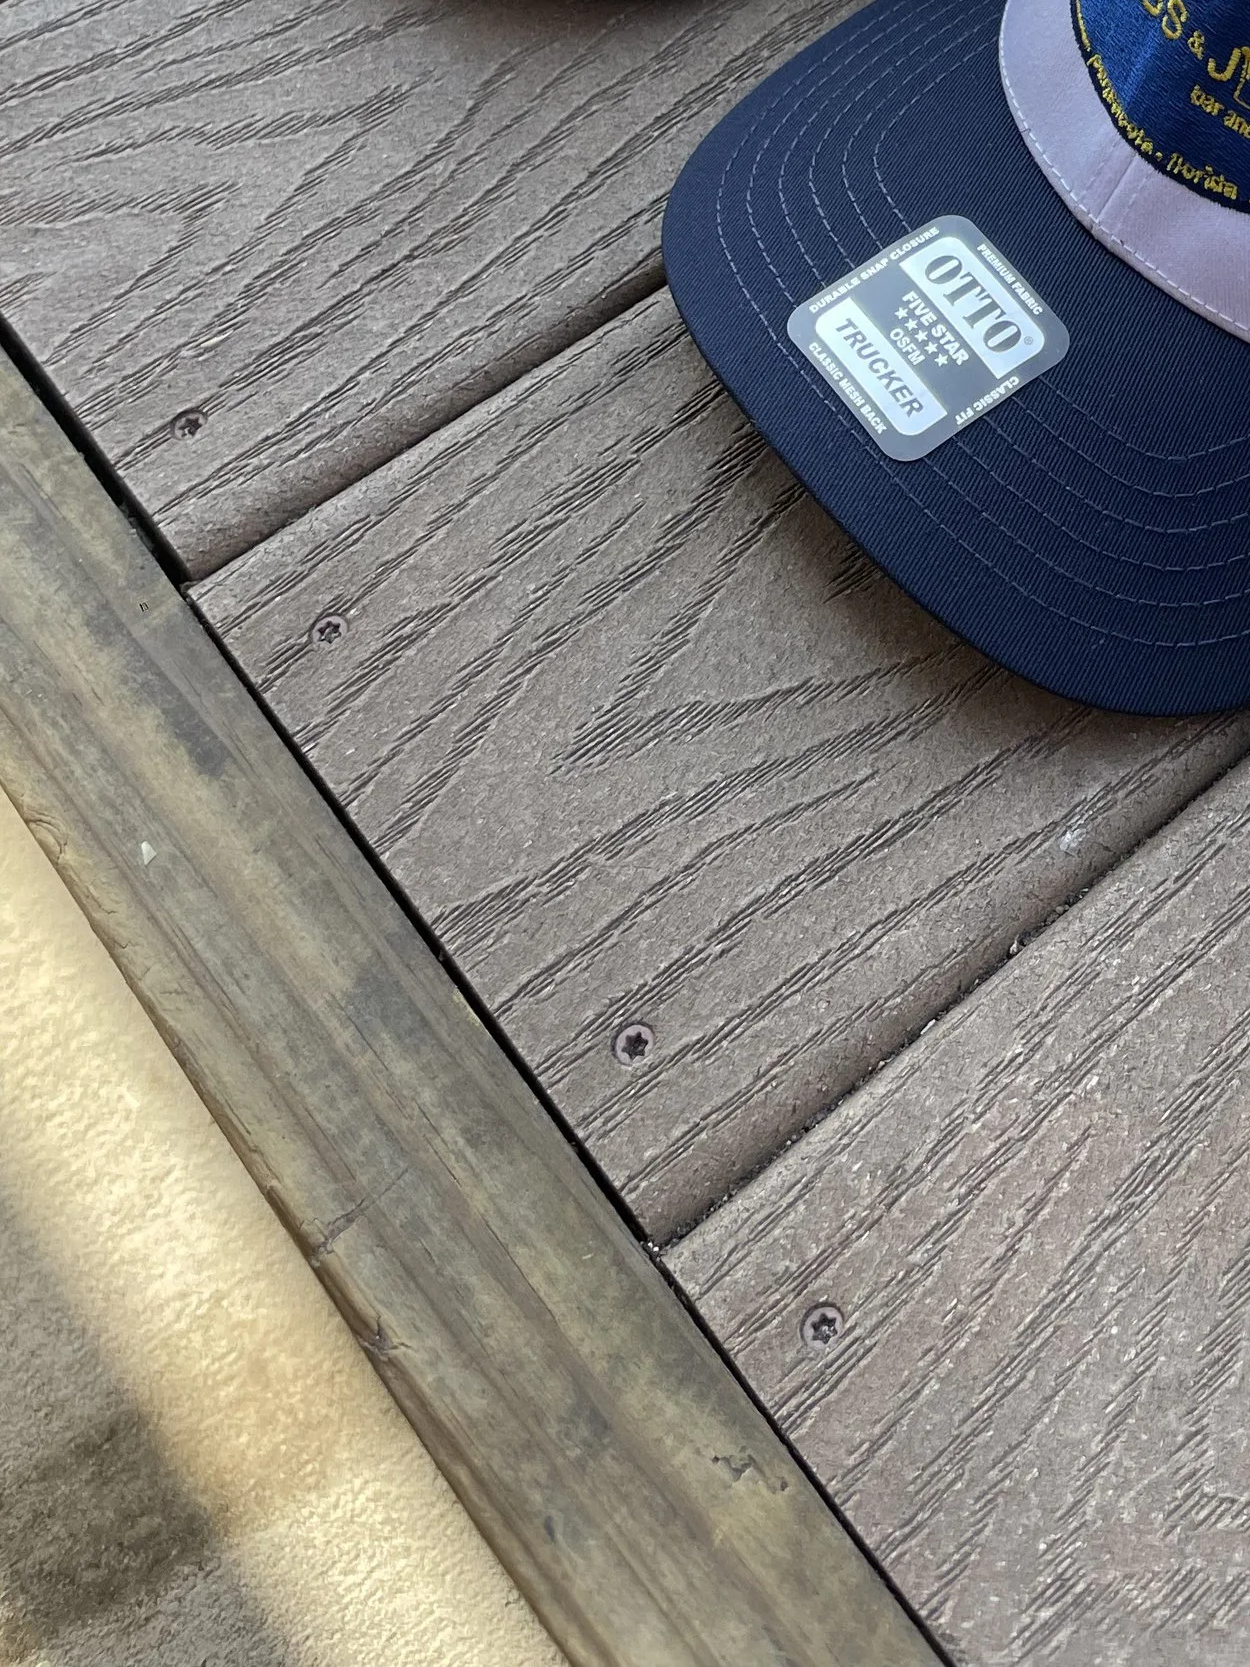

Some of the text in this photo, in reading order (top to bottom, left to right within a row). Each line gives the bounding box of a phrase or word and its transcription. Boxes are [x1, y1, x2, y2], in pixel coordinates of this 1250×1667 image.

[1187, 30, 1205, 60] &
[1190, 84, 1224, 116] bar
[1166, 152, 1238, 200] florida
[809, 226, 940, 314] DURABLE SNAP CLOSURE
[976, 243, 1044, 316] PREMIUM FABRIC
[889, 327, 926, 366] OSFM
[901, 290, 970, 366] FIVE STAR
[809, 342, 888, 435] CLASSIC MESH BACK
[835, 317, 924, 418] TRUCKER
[955, 376, 1020, 426] CLASSIC FIT
